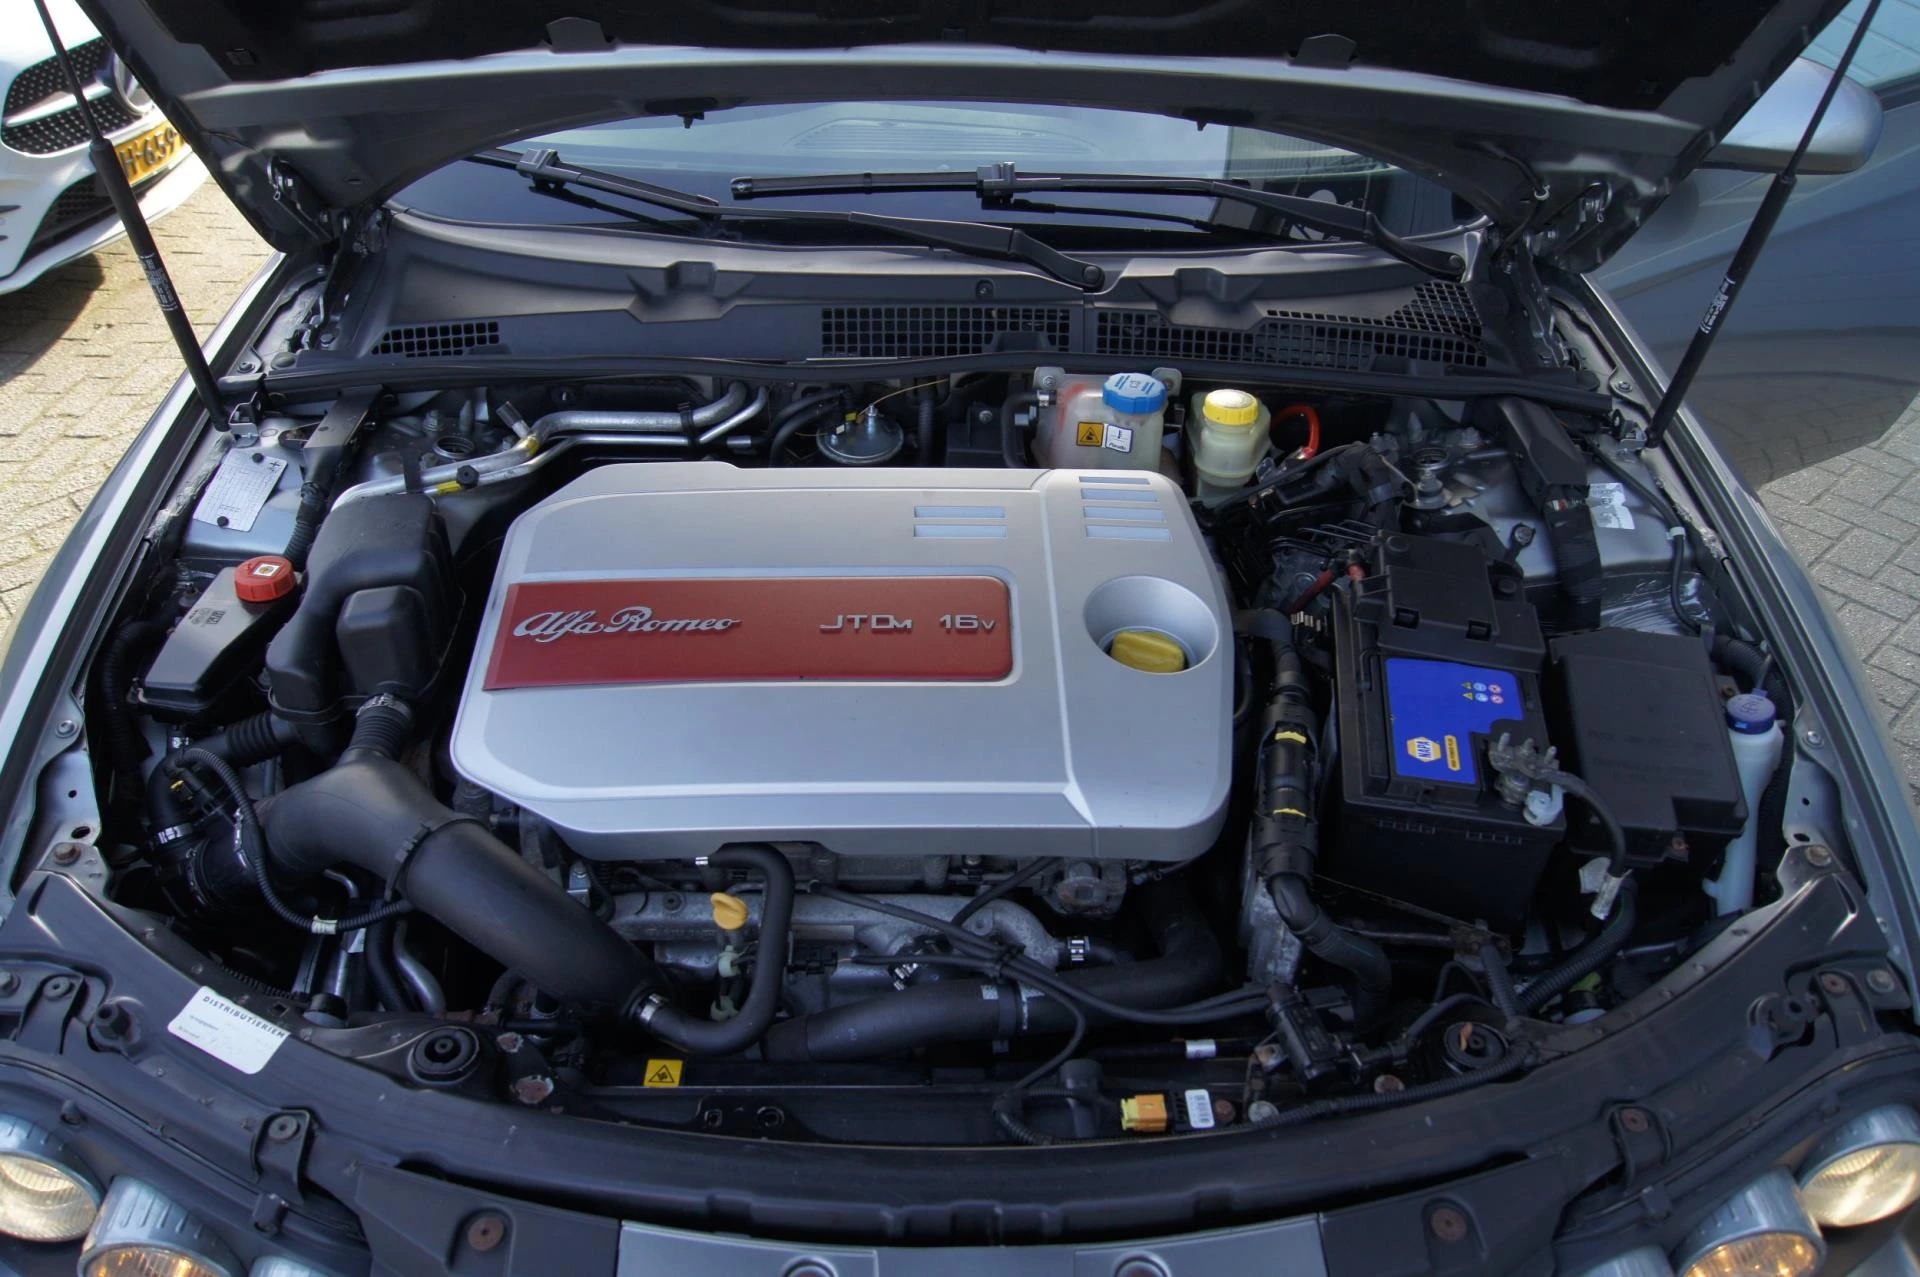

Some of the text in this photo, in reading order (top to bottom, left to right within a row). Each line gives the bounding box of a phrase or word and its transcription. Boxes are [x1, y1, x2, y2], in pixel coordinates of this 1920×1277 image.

[513, 606, 741, 643] Alfa Romeo
[1416, 741, 1432, 758] NAPA
[202, 995, 286, 1039] DISTRIBUTIERIEM
